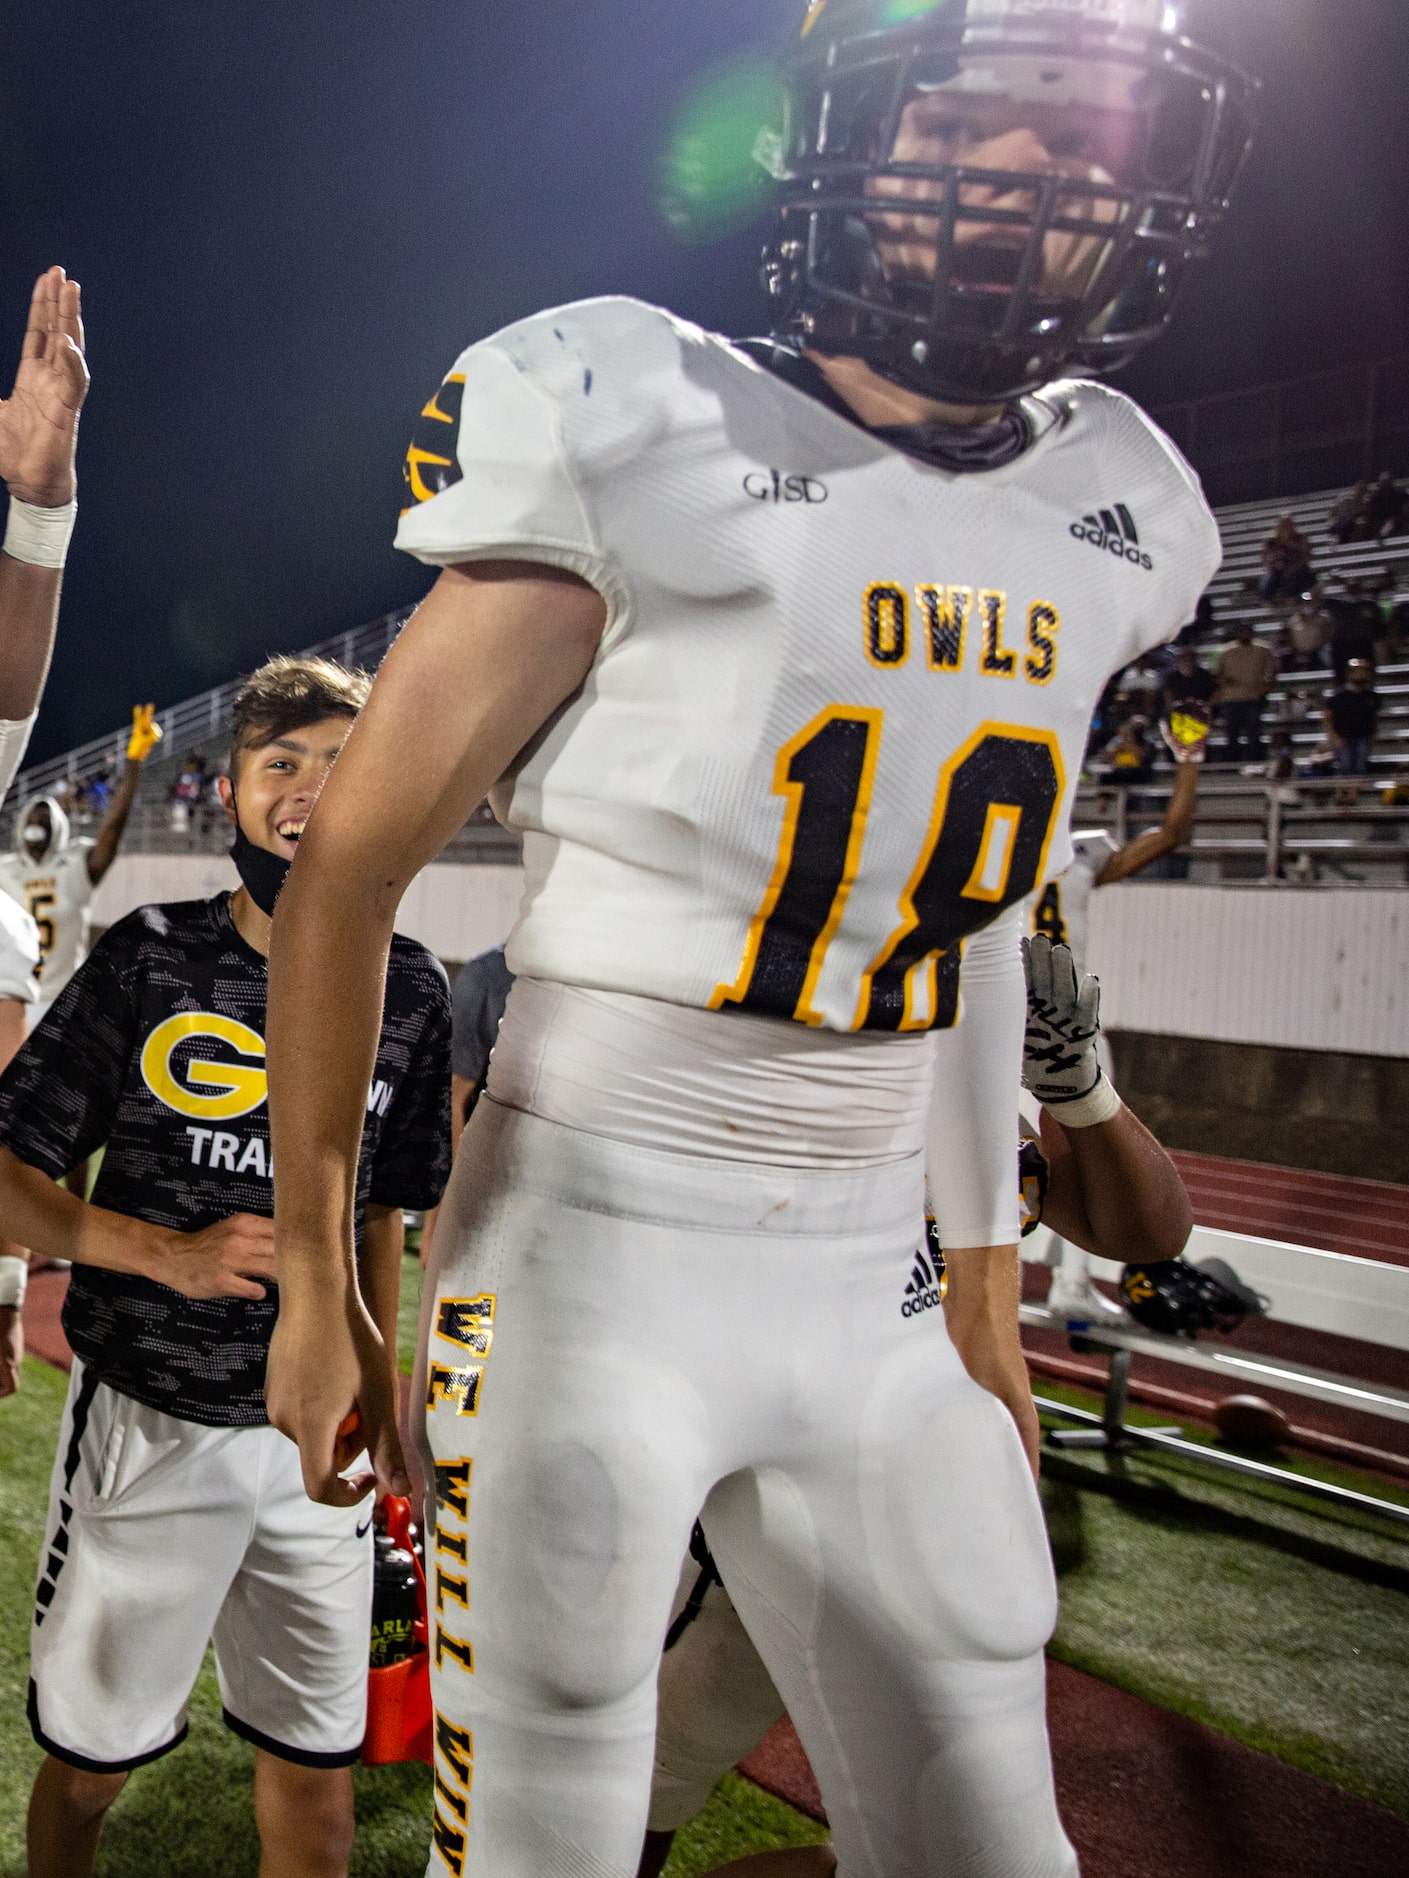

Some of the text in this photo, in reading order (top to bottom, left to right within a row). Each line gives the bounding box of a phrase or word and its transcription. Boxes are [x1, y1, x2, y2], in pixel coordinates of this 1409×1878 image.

[1069, 523, 1153, 571] adidas
[862, 579, 1061, 686] OWLS
[708, 703, 1066, 1031] 18
[140, 1010, 269, 1121] G
[185, 1126, 274, 1179] TRA
[426, 1291, 497, 1878] WE WILL WIN
